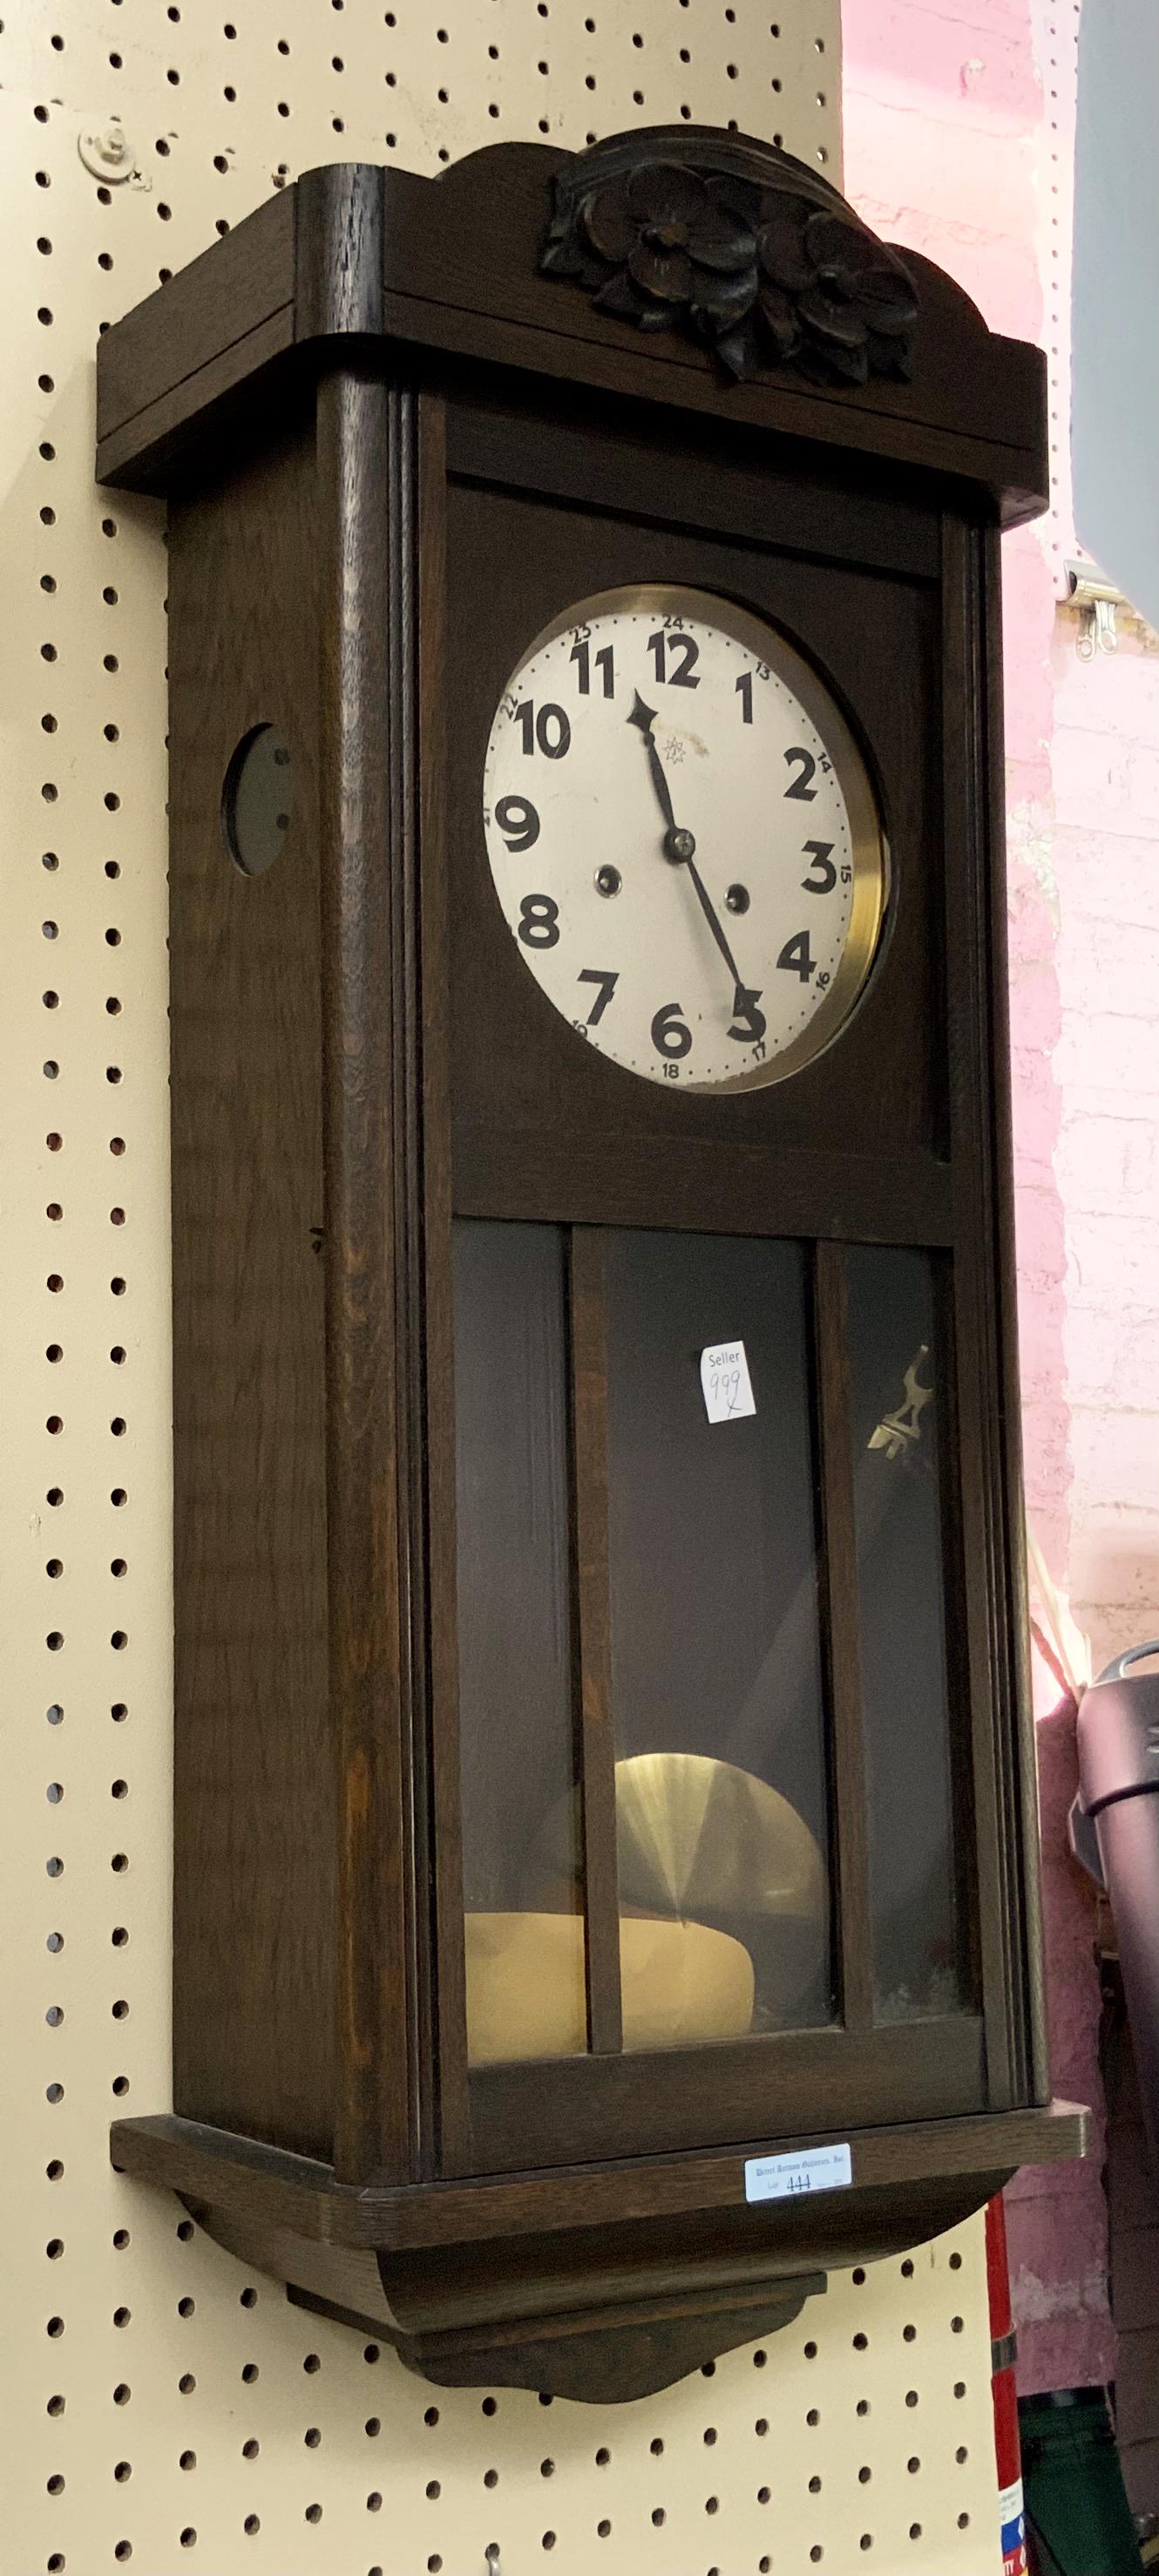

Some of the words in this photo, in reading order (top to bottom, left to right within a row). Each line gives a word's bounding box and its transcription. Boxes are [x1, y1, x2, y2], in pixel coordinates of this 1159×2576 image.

[662, 613, 684, 630] 24
[569, 640, 614, 699] 11
[647, 629, 701, 690] 12
[755, 661, 770, 681] 13
[735, 670, 753, 724] 1
[513, 698, 571, 760] 10
[783, 746, 818, 802] 2
[817, 752, 832, 774] 14
[494, 794, 540, 853] 9
[801, 839, 837, 894] 3
[840, 865, 851, 884] 15
[518, 894, 560, 950] 8
[776, 929, 817, 983] 4
[816, 971, 830, 991] 16
[577, 969, 620, 1026] 7
[726, 986, 767, 1043] 5
[651, 1003, 692, 1059] 6
[752, 1041, 766, 1061] 17
[662, 1062, 680, 1079] 18
[708, 1352, 740, 1367] Seller
[710, 1370, 740, 1402] 999
[786, 2173, 811, 2192] 444
